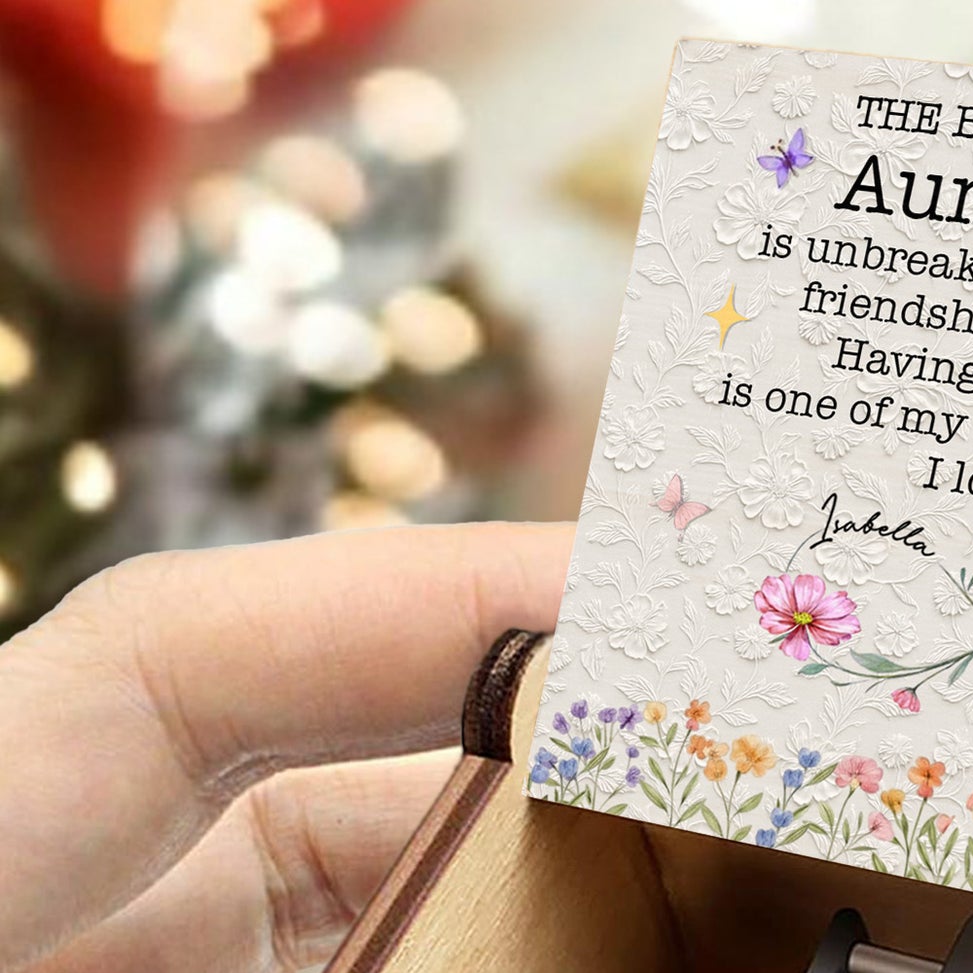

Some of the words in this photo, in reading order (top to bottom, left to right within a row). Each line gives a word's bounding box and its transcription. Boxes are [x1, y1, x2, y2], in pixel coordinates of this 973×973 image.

[856, 95, 943, 135] THE
[757, 223, 793, 259] is
[718, 371, 753, 408] is
[765, 387, 838, 420] one
[849, 396, 895, 429] of
[896, 406, 970, 445] my
[922, 456, 945, 491] I
[809, 492, 935, 558] Isabella
